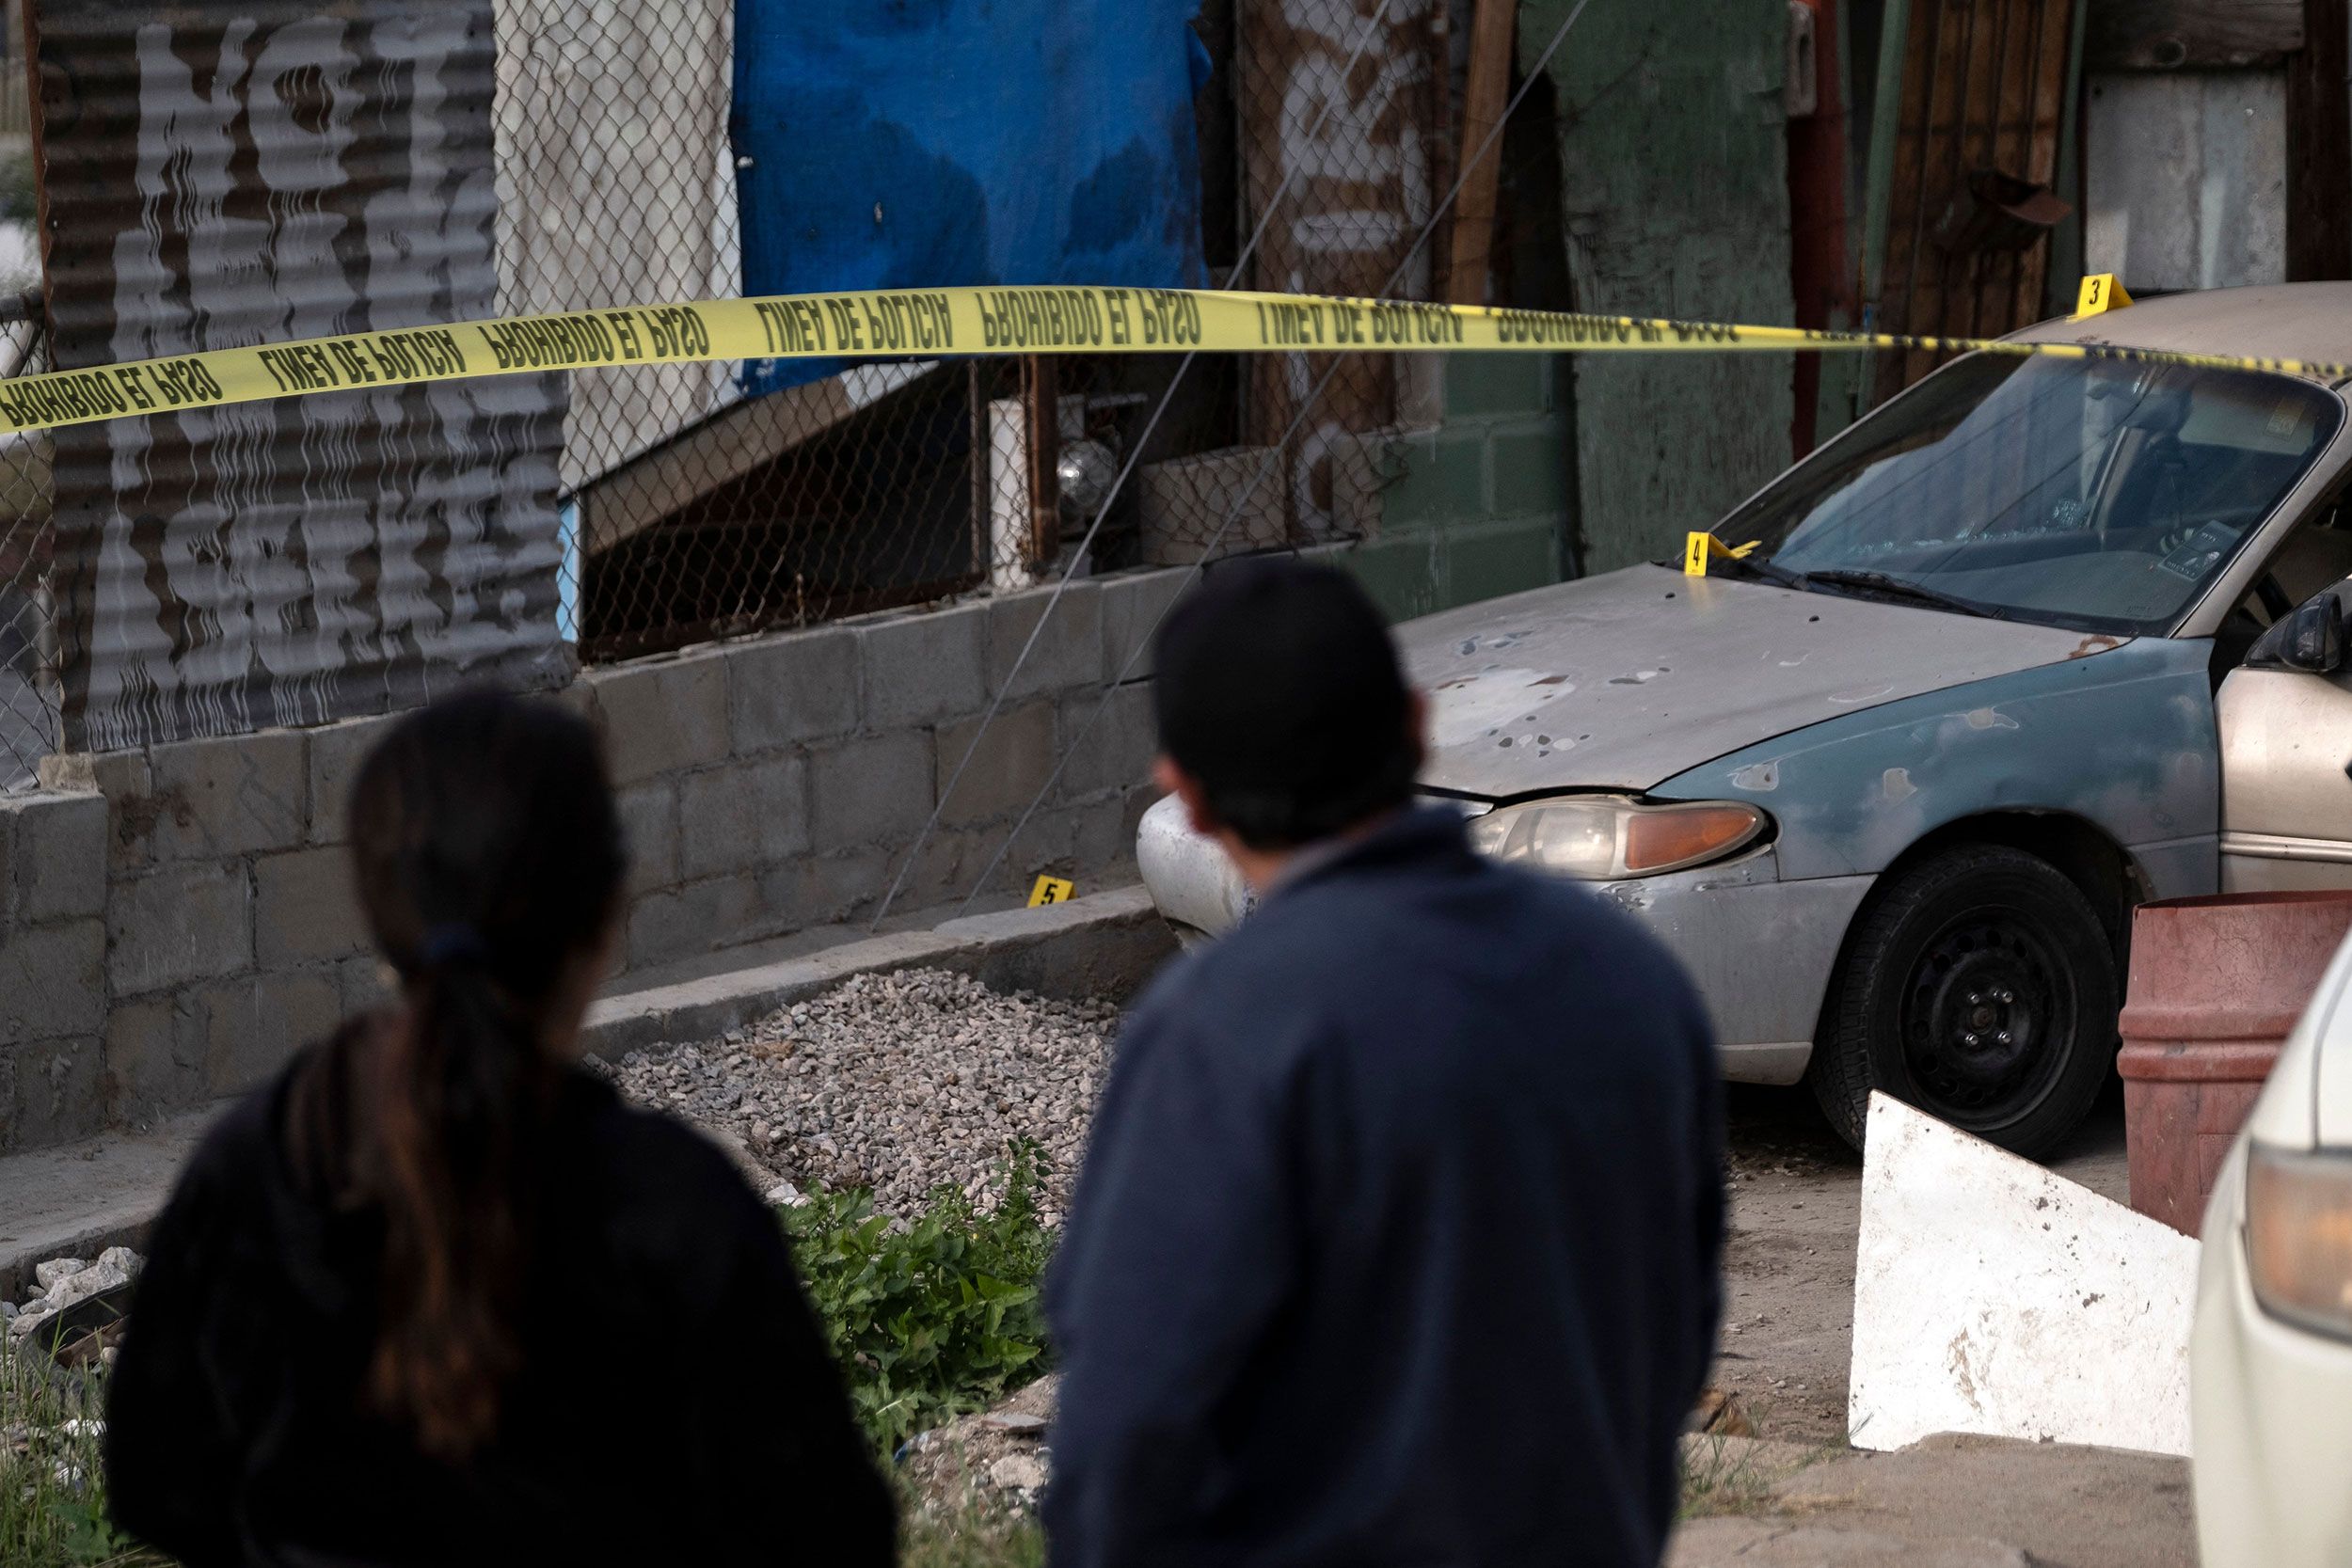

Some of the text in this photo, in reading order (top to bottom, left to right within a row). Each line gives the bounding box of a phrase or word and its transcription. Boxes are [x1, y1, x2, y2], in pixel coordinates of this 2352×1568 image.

[2089, 278, 2101, 305] 3
[1692, 538, 1701, 567] 4
[1041, 882, 1058, 905] 5
